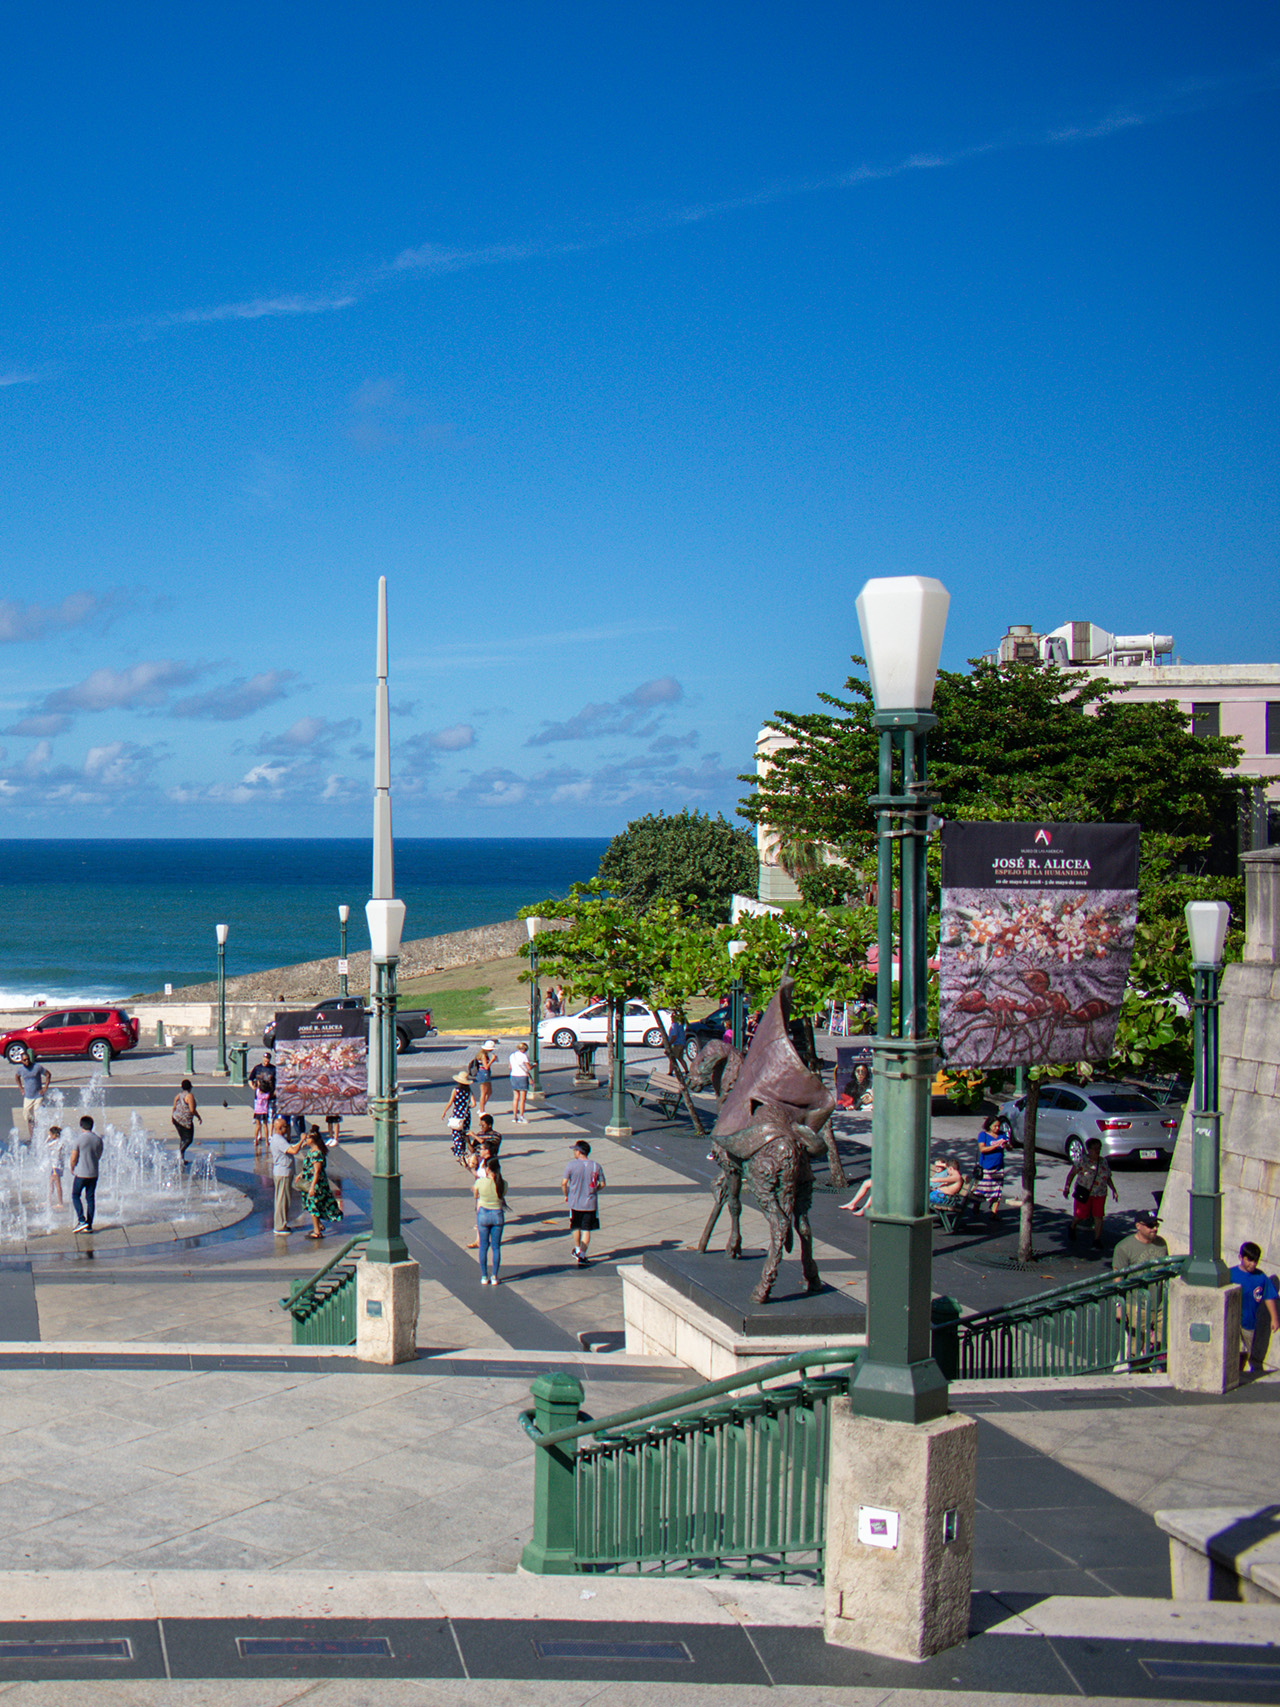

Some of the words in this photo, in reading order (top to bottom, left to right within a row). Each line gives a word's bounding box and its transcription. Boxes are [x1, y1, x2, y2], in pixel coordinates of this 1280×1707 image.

[992, 856, 1025, 868] JOSÉ
[1028, 859, 1040, 868] R.
[1044, 859, 1091, 869] ALICEA
